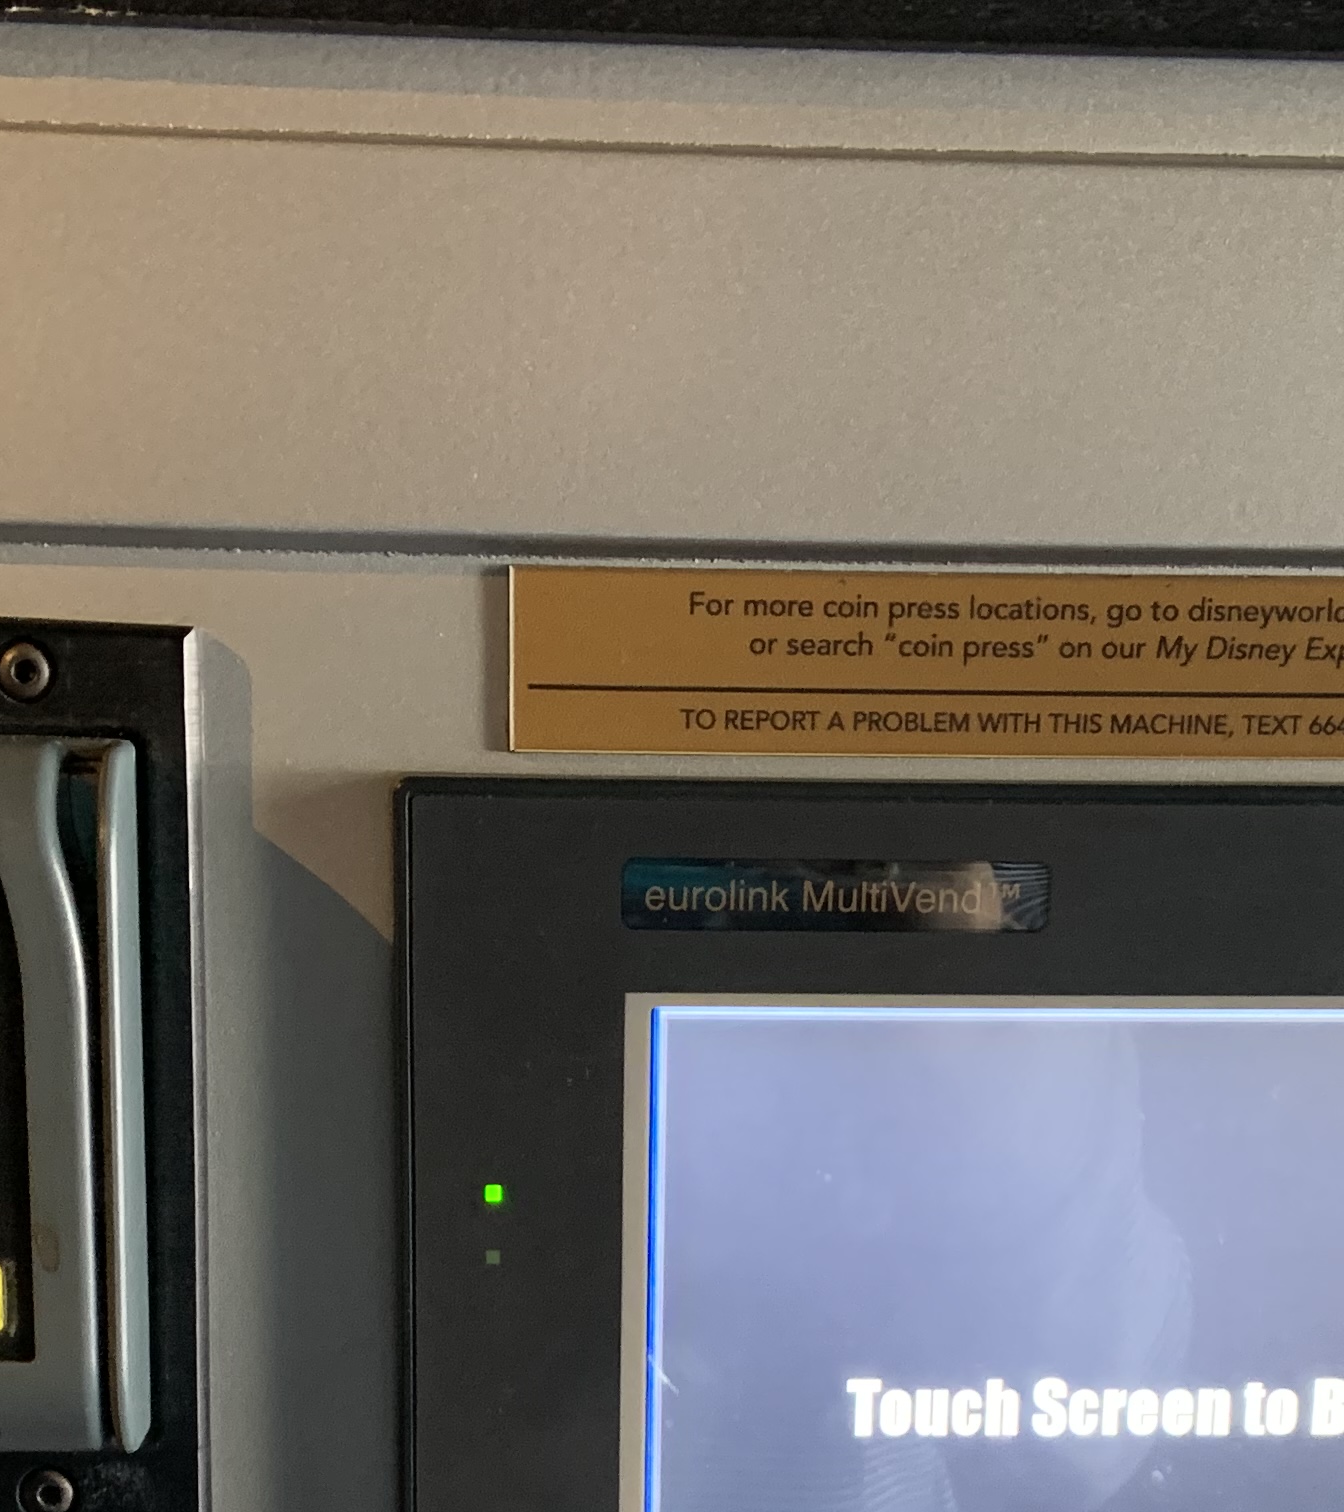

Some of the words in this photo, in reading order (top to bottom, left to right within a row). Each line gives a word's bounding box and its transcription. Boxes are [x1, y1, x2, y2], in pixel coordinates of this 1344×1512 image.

[689, 592, 733, 618] For
[744, 598, 813, 618] more
[824, 595, 877, 619] coin
[889, 599, 960, 626] press
[970, 595, 1096, 625] locations,
[1107, 601, 1141, 628] go
[1151, 599, 1178, 622] to
[749, 636, 775, 655] or
[786, 632, 873, 656] search
[1059, 639, 1091, 658] on
[1102, 640, 1145, 659] our
[1156, 636, 1198, 665] My
[1206, 636, 1296, 667] Disney
[680, 708, 716, 731] TO
[725, 709, 820, 732] REPORT
[827, 711, 846, 731] A
[854, 711, 970, 733] PROBLEM
[977, 713, 1041, 734] WITH
[1048, 713, 1102, 734] THIS
[1110, 713, 1233, 738] MACHINE,
[1241, 714, 1302, 735] TEXT
[644, 879, 789, 912] eurolink
[845, 1376, 1020, 1439] Touch
[1031, 1375, 1231, 1439] Screen
[1244, 1378, 1299, 1437] to
